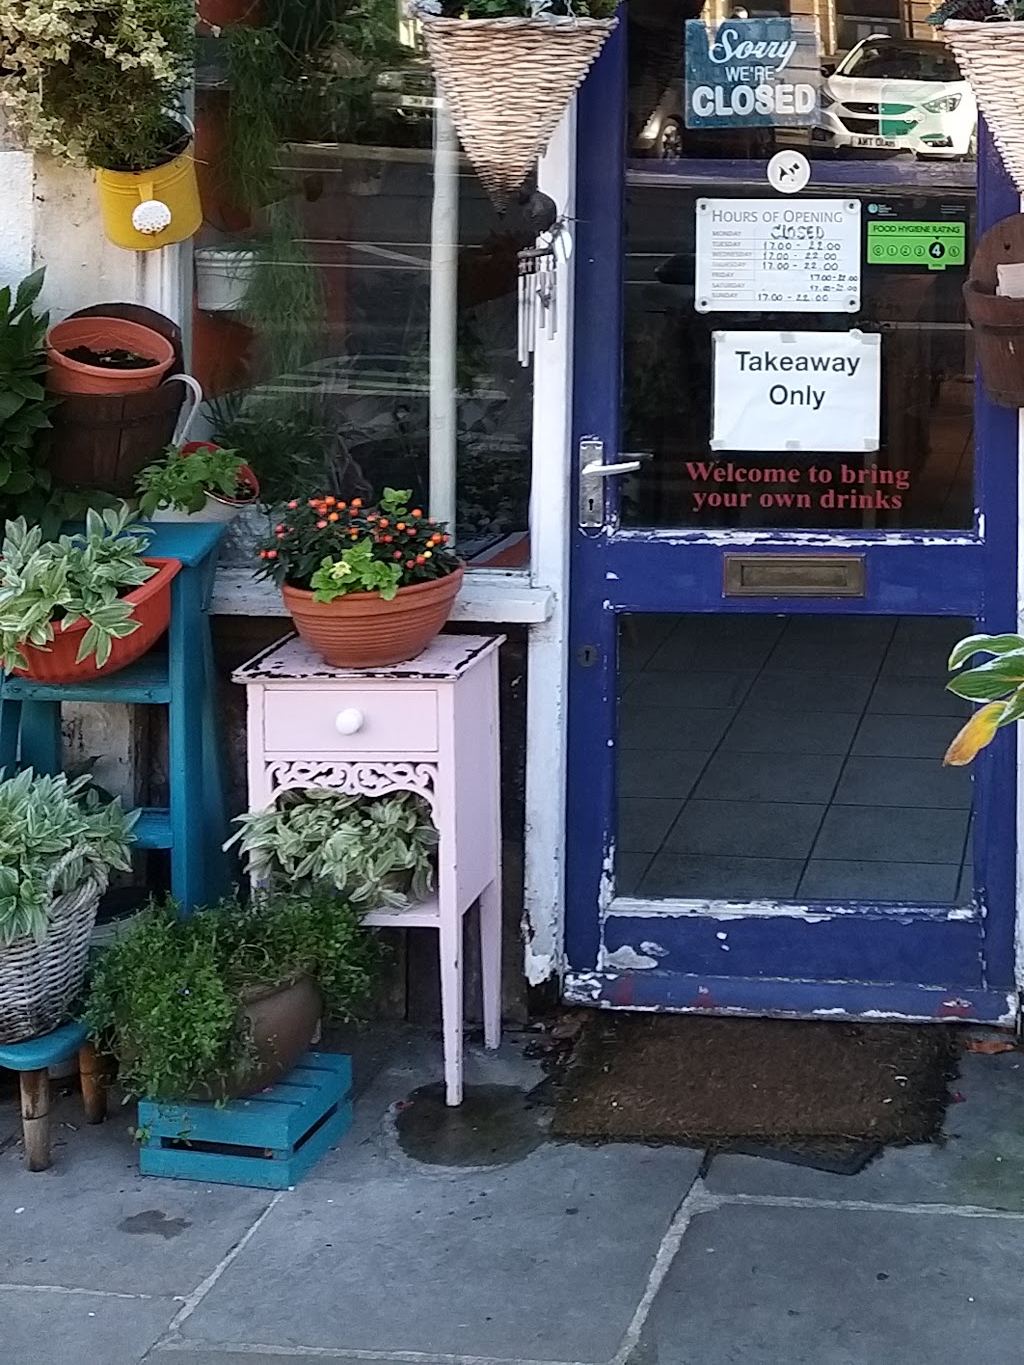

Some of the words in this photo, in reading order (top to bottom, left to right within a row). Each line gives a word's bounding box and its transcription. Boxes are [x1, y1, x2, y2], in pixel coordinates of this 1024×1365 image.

[708, 29, 797, 72] Sorry
[725, 66, 775, 82] WE'RE
[692, 85, 817, 117] CLOSED
[712, 210, 758, 223] HOURS
[762, 212, 780, 223] OF
[783, 210, 843, 223] OPENING
[771, 224, 825, 240] CLOSED
[873, 225, 897, 233] FOOD
[898, 225, 930, 233] HYGIENE
[932, 225, 960, 233] RATING
[931, 244, 941, 256] 4
[735, 351, 861, 377] Takeaway
[769, 385, 826, 411] Only
[685, 462, 800, 483] Welcome
[808, 466, 832, 484] to
[841, 464, 911, 490] bring
[693, 492, 752, 512] your
[759, 493, 812, 509] own
[820, 489, 903, 509] drinks
